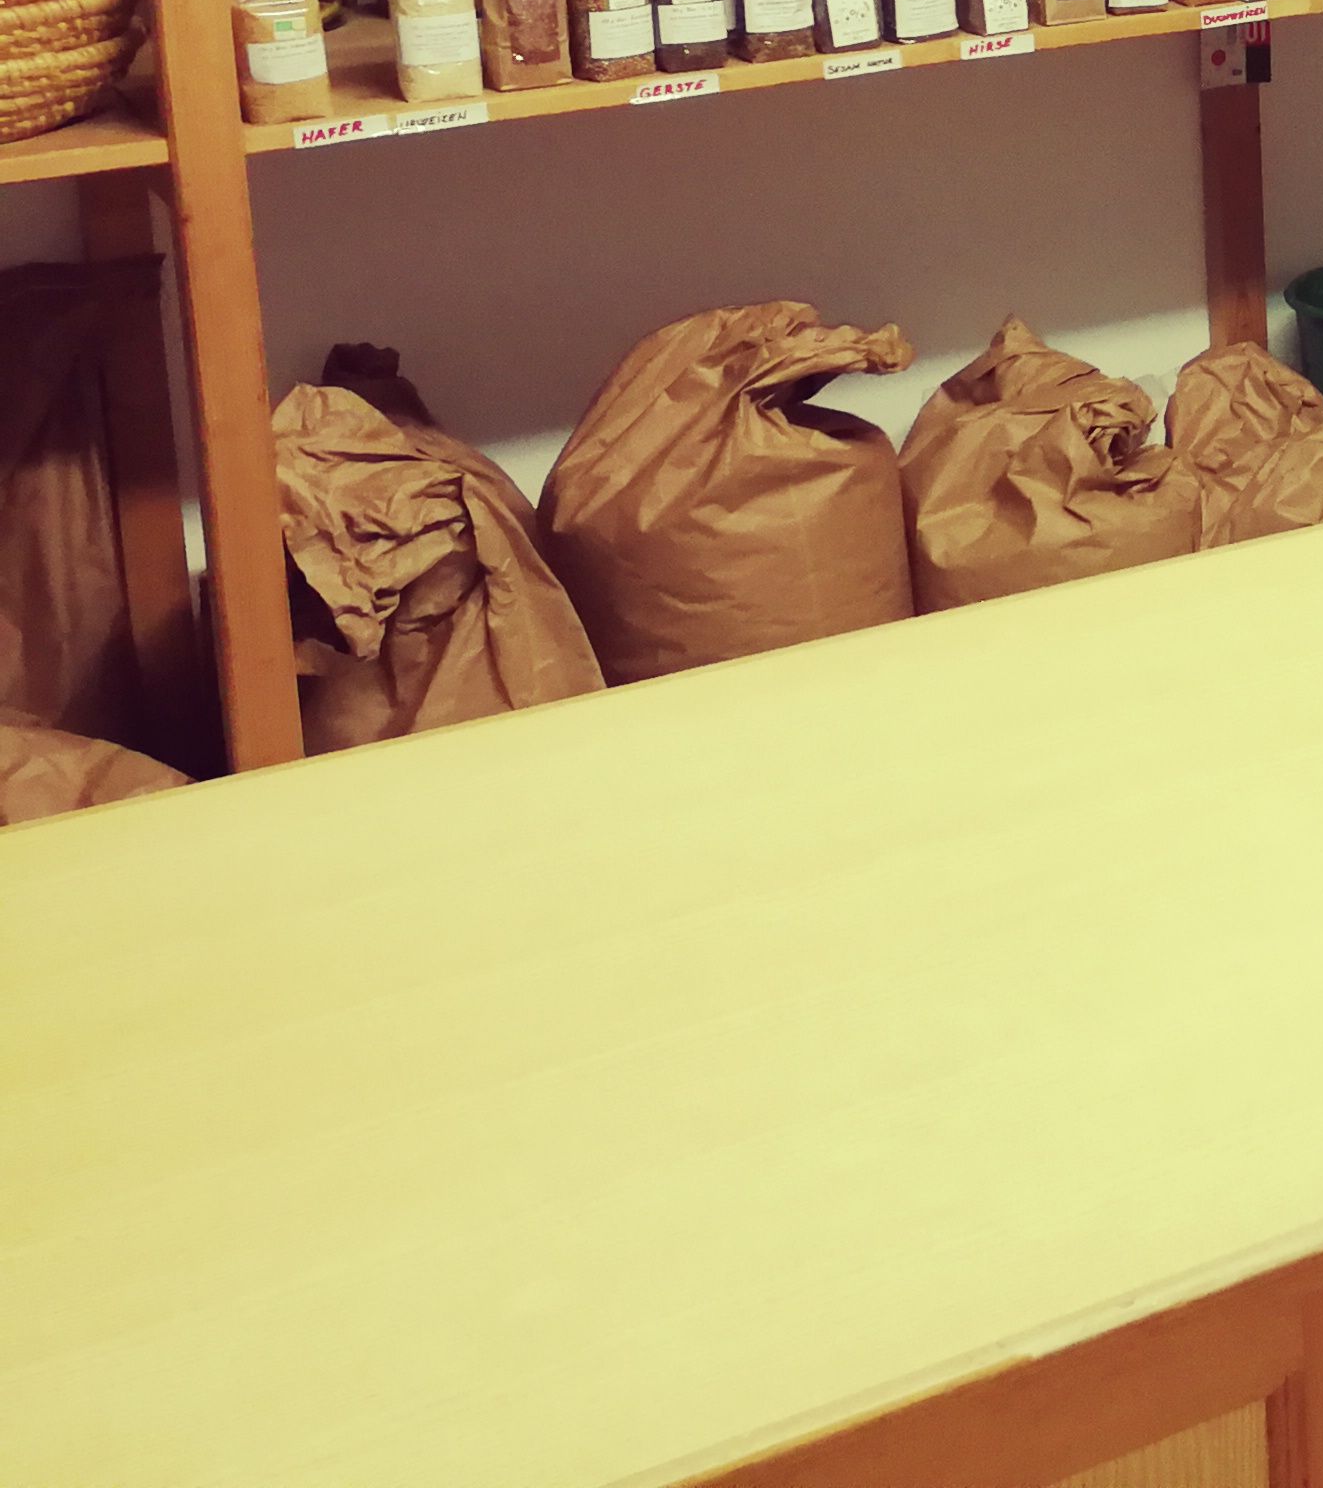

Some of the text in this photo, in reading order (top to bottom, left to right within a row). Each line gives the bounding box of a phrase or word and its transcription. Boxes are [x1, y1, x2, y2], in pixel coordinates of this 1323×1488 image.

[968, 36, 1014, 55] HIRSE
[639, 78, 708, 99] GERSTE
[301, 120, 364, 145] HAFER
